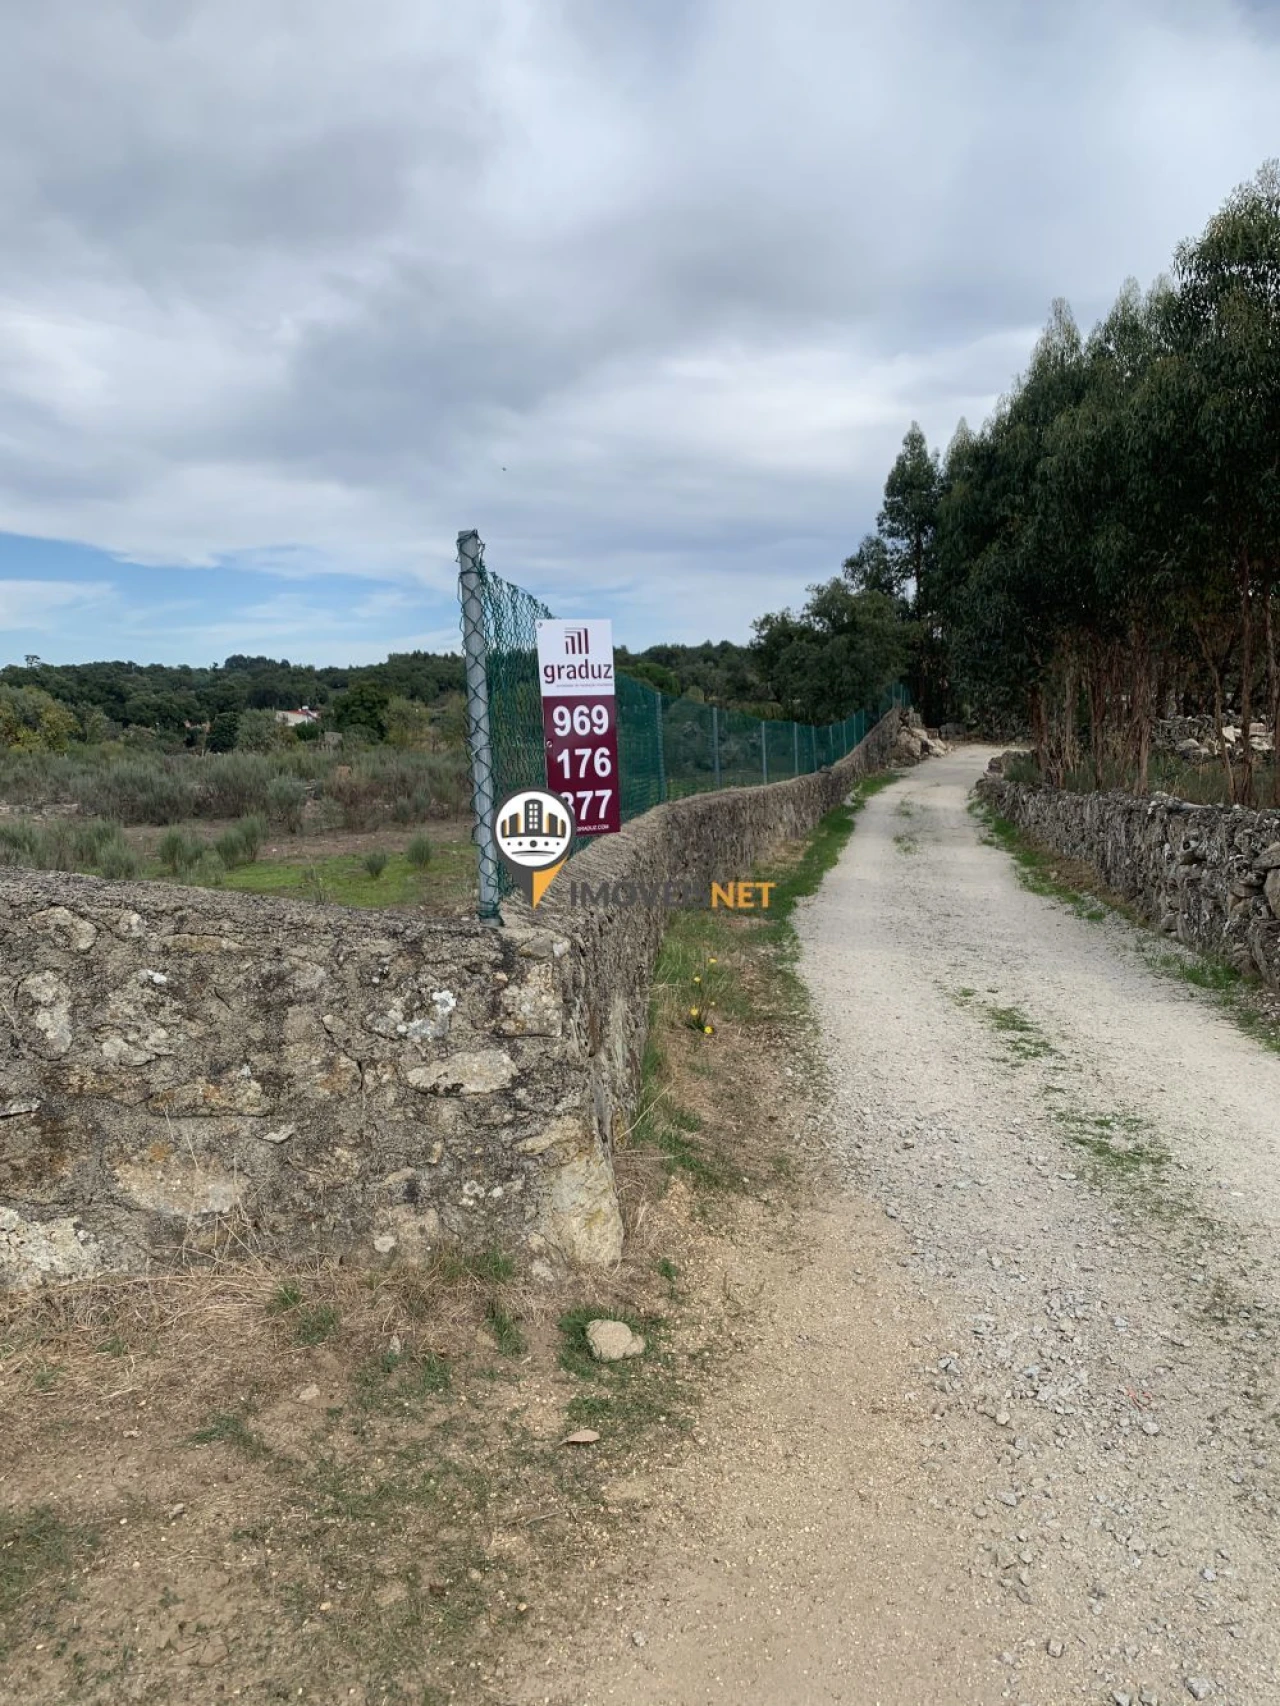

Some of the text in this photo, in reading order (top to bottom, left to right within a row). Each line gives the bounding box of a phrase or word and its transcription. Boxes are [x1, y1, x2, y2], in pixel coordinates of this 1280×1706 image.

[543, 659, 613, 684] graduz
[552, 704, 609, 737] 969
[557, 747, 612, 779] 176
